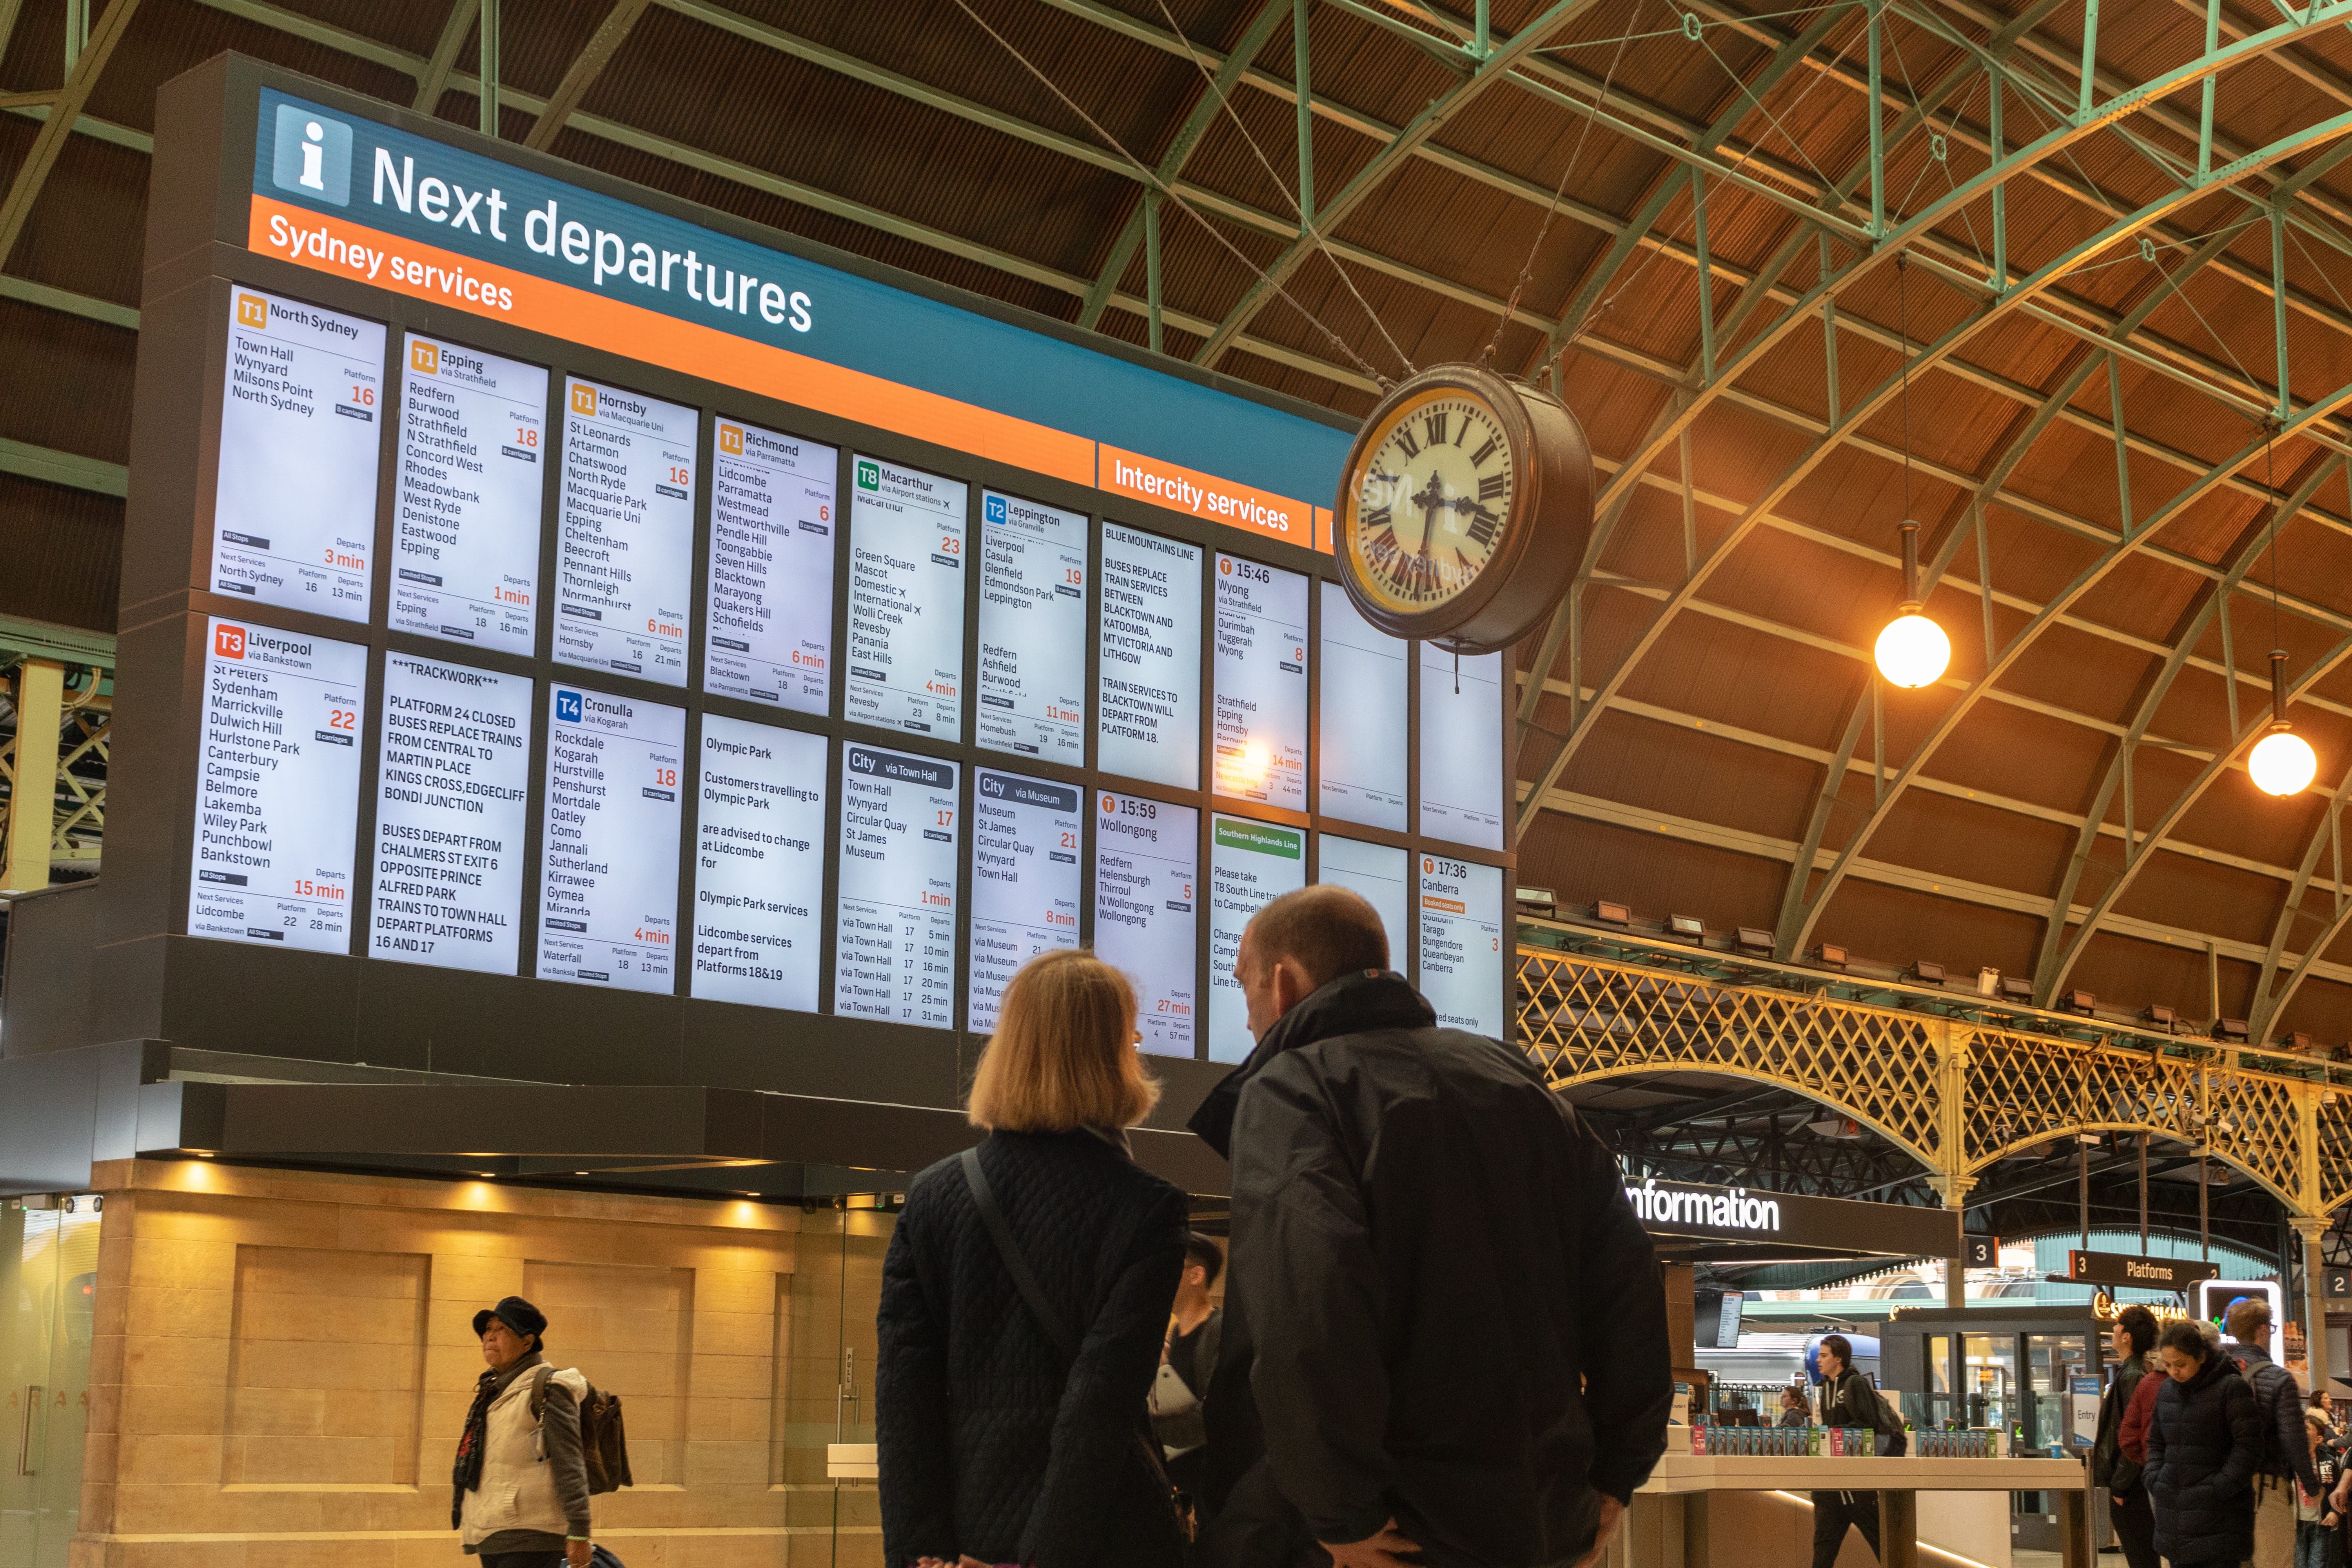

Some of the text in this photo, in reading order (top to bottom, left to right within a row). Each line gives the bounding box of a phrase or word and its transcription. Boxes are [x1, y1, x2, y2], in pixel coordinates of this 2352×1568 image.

[374, 148, 811, 331] Next departures
[270, 215, 512, 310] Sydney services
[242, 301, 263, 322] T1
[270, 303, 358, 340] North Sydney
[415, 347, 434, 367] T1
[441, 350, 483, 374] Epping
[234, 368, 313, 399] Milsons Point
[344, 368, 375, 383] Platform
[441, 368, 496, 388] via Strathfield
[352, 386, 374, 405] 16
[599, 392, 646, 417] Hornsby
[517, 428, 537, 447] 18
[570, 421, 631, 446] St Leonards
[746, 432, 799, 456] Richmond
[406, 444, 483, 473] Concord West
[569, 451, 626, 475] Chatswood
[746, 448, 755, 457] via
[757, 450, 795, 467] Parramatta
[860, 467, 877, 485] T8
[882, 468, 933, 492] Macarthur
[404, 475, 479, 503] Meadowbank
[881, 484, 941, 506] via Airport stations
[1116, 460, 1288, 531] Intercity services
[989, 502, 1004, 518] T2
[1008, 503, 1060, 526] Leppington
[717, 509, 789, 537] Wentworthville
[232, 533, 249, 542] Stops
[942, 536, 959, 554] 23
[1105, 528, 1194, 561] BLUE MOUNTAINS LINE
[325, 549, 364, 570] 3 min
[504, 574, 530, 586] Departs
[1105, 557, 1167, 583] BUSES REPLACE
[1237, 563, 1269, 584] 15:46
[985, 575, 1054, 601] Edmondson Park
[1218, 578, 1249, 600] Wyong
[713, 597, 771, 619] Quakers Hill
[854, 589, 912, 612] International
[853, 603, 903, 624] Wolli Creek
[648, 619, 682, 638] 6 min
[1104, 617, 1151, 639] KATOOMBA,
[1284, 633, 1303, 643] Platform
[219, 632, 242, 652] T3
[249, 632, 312, 656] Liverpool
[1218, 630, 1252, 647] Tuggerah
[248, 651, 311, 670] via Bankstown
[711, 655, 746, 668] Next Services
[1103, 647, 1141, 664] LITHGOW
[1295, 647, 1303, 661] 8
[982, 657, 1016, 674] Ashfield
[212, 695, 283, 719] Marrickville
[390, 695, 515, 728] PLATFORM 24 CLOSED
[560, 697, 579, 715] T4
[584, 697, 633, 718] Cronulla
[1047, 706, 1079, 723] 11 min
[330, 710, 355, 730] 22
[584, 714, 628, 729] via Kogarah
[1217, 720, 1248, 737] Hornsby
[209, 728, 299, 755] Hurlstone Park
[555, 730, 604, 750] Rockdale
[706, 737, 771, 760] Olympic Park
[656, 768, 675, 786] 18
[852, 753, 937, 781] City via Town Hall
[983, 778, 1060, 804] City via Museum
[1331, 786, 1348, 794] Services
[937, 810, 953, 826] 17
[1120, 799, 1156, 819] 15:59
[847, 811, 907, 834] Circular Quay
[978, 818, 1016, 835] St James
[1100, 817, 1157, 842] Wollongong
[702, 824, 810, 852] are advised to change
[1061, 832, 1076, 849] 21
[1219, 828, 1297, 849] Southern Highlands Line
[548, 855, 608, 874] Sutherland
[1215, 866, 1257, 883] Please take
[1439, 861, 1466, 879] 17:36
[1100, 867, 1150, 887] Helensburgh
[1422, 878, 1459, 895] Canberra
[378, 879, 456, 901] ALFRED PARK
[1184, 884, 1191, 899] 5
[196, 905, 244, 920] Lidcombe
[1425, 898, 1442, 907] Booked
[1453, 904, 1464, 914] only
[376, 935, 435, 953] 16 AND 17
[1423, 935, 1463, 951] Bungendore
[1492, 938, 1498, 951] 3
[1423, 947, 1464, 964] Queanbeyan
[697, 959, 782, 981] Platforms 18&19
[922, 978, 948, 990] 20 min
[1626, 1179, 1780, 1231] nformation
[1976, 1244, 1987, 1261] 3
[2079, 1257, 2086, 1273] 3
[2127, 1261, 2173, 1280] Platforms
[2335, 1277, 2345, 1291] 2
[2078, 1410, 2096, 1421] Entry
